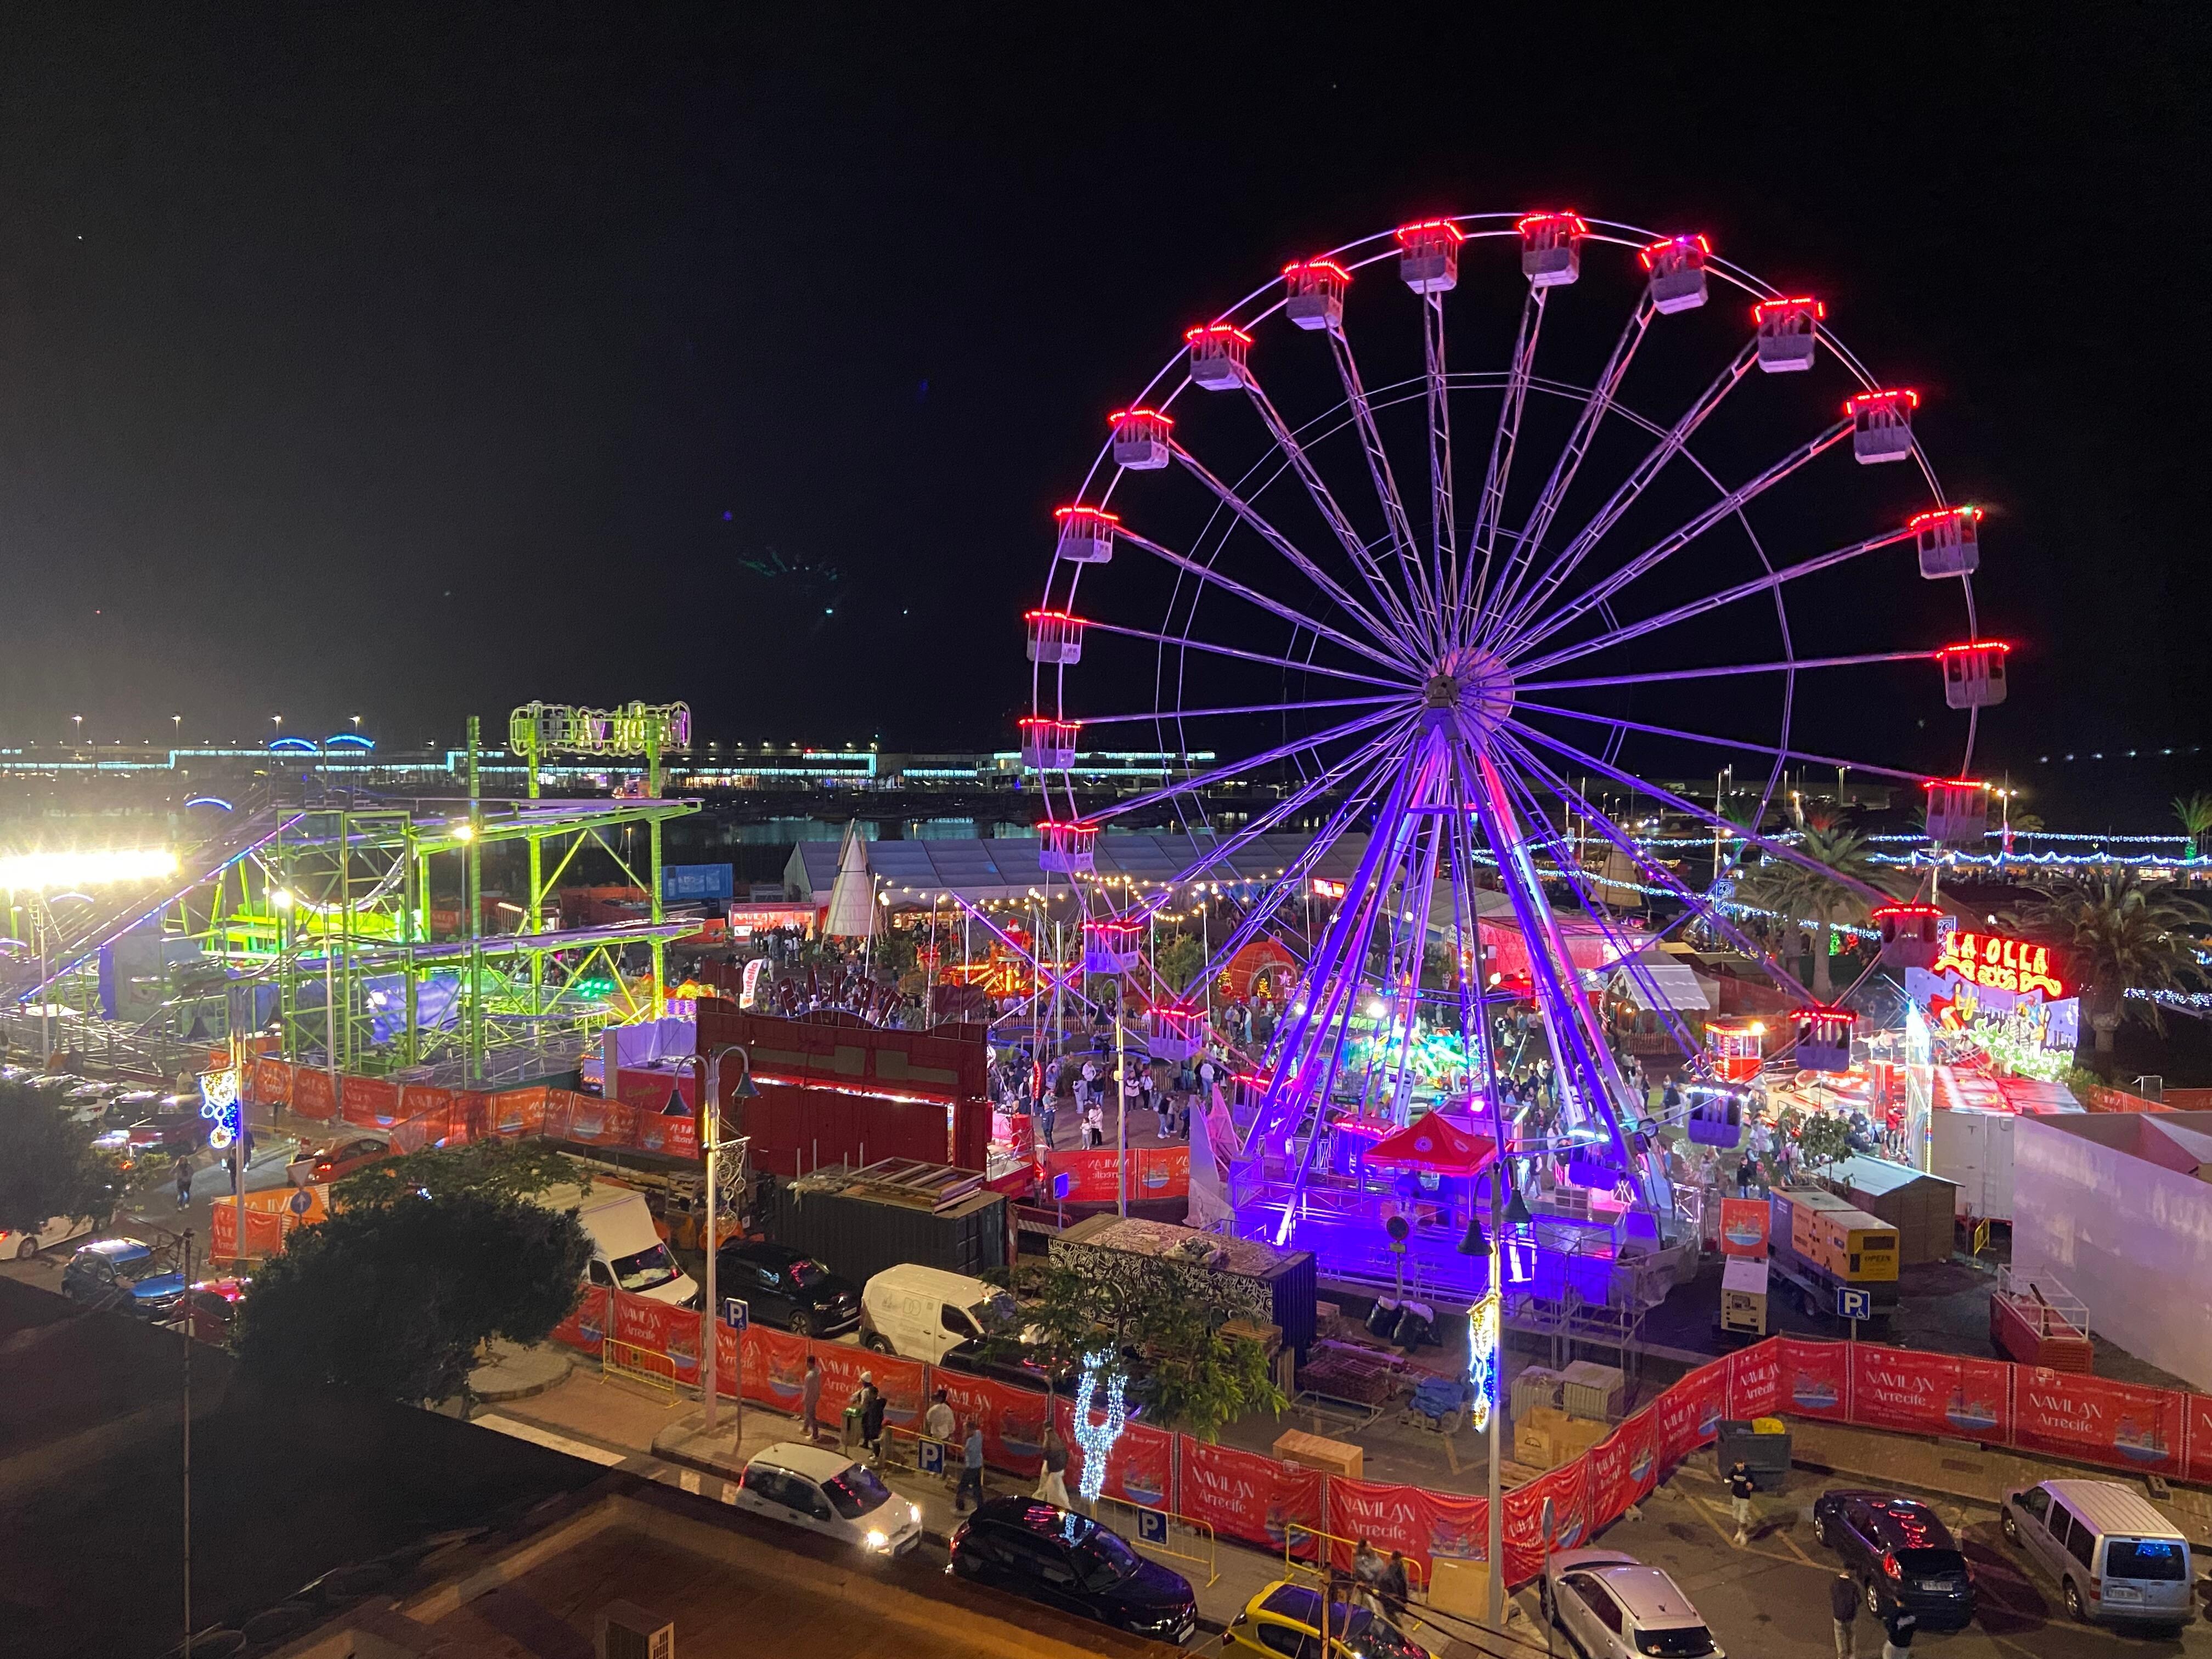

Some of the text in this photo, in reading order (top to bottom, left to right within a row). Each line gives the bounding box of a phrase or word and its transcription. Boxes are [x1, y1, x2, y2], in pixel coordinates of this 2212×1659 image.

[1946, 931, 2049, 976] LA OLLA
[746, 962, 758, 997] nutella
[730, 1303, 743, 1325] P
[1844, 1292, 1863, 1313] P
[1866, 1371, 1935, 1393] NAVILAN
[1873, 1388, 1926, 1406] Arrecife
[2029, 1392, 2103, 1419] NAVILAN
[2037, 1413, 2094, 1434] Arrecife
[921, 1442, 938, 1467] P
[1193, 1466, 1254, 1499] NAVILAN
[1198, 1488, 1246, 1514] Arrecife
[1339, 1495, 1416, 1523] NAVILAN
[1141, 1512, 1159, 1536] P
[1347, 1519, 1407, 1541] Arrecife
